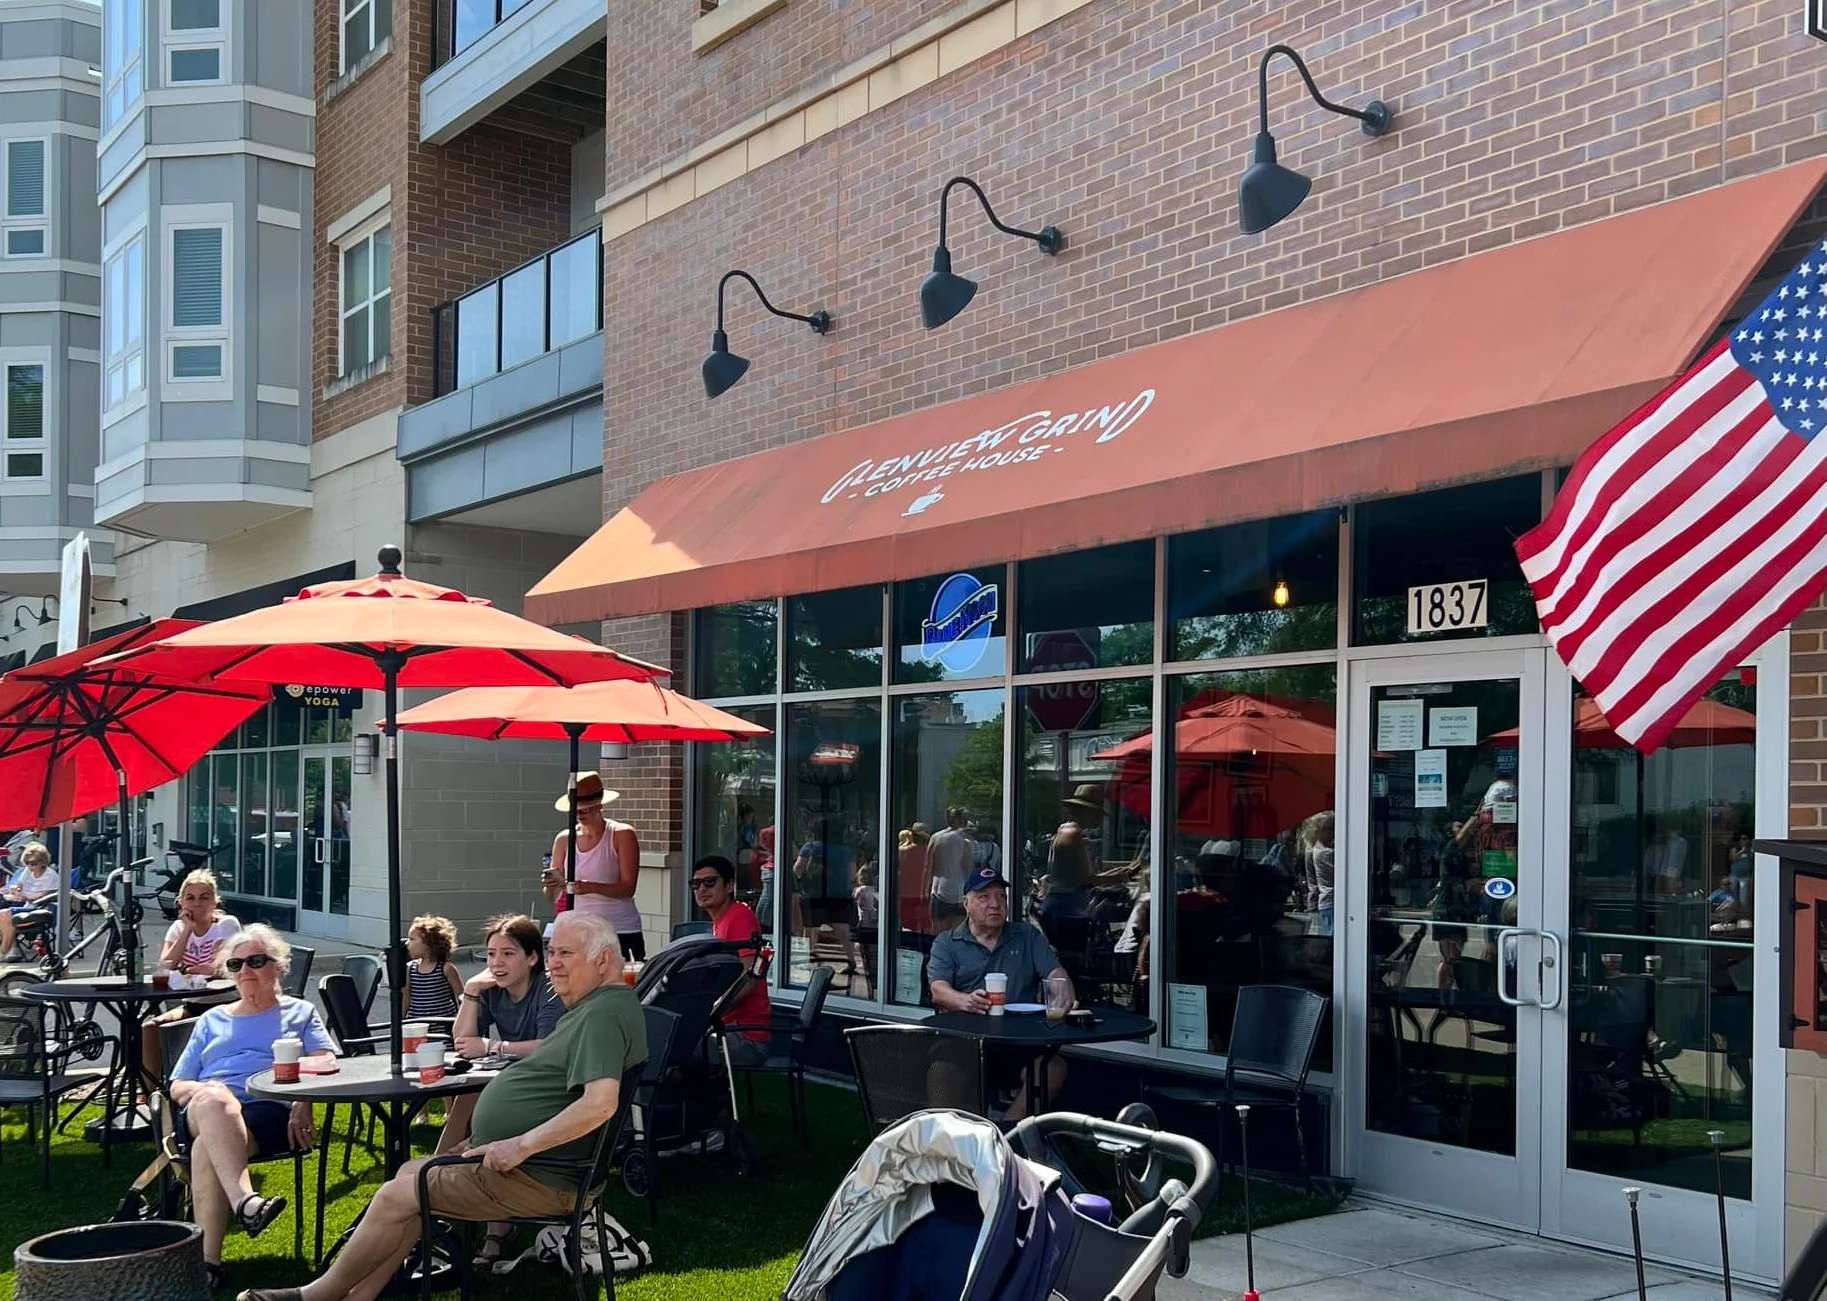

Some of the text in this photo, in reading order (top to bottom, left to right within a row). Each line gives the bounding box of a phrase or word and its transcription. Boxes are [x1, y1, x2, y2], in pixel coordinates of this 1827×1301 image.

[821, 389, 1156, 504] GLENVIEW GRIND
[865, 444, 1052, 499] COFFEE HOUSE
[1413, 582, 1486, 630] 1837
[304, 697, 339, 707] YOGA
